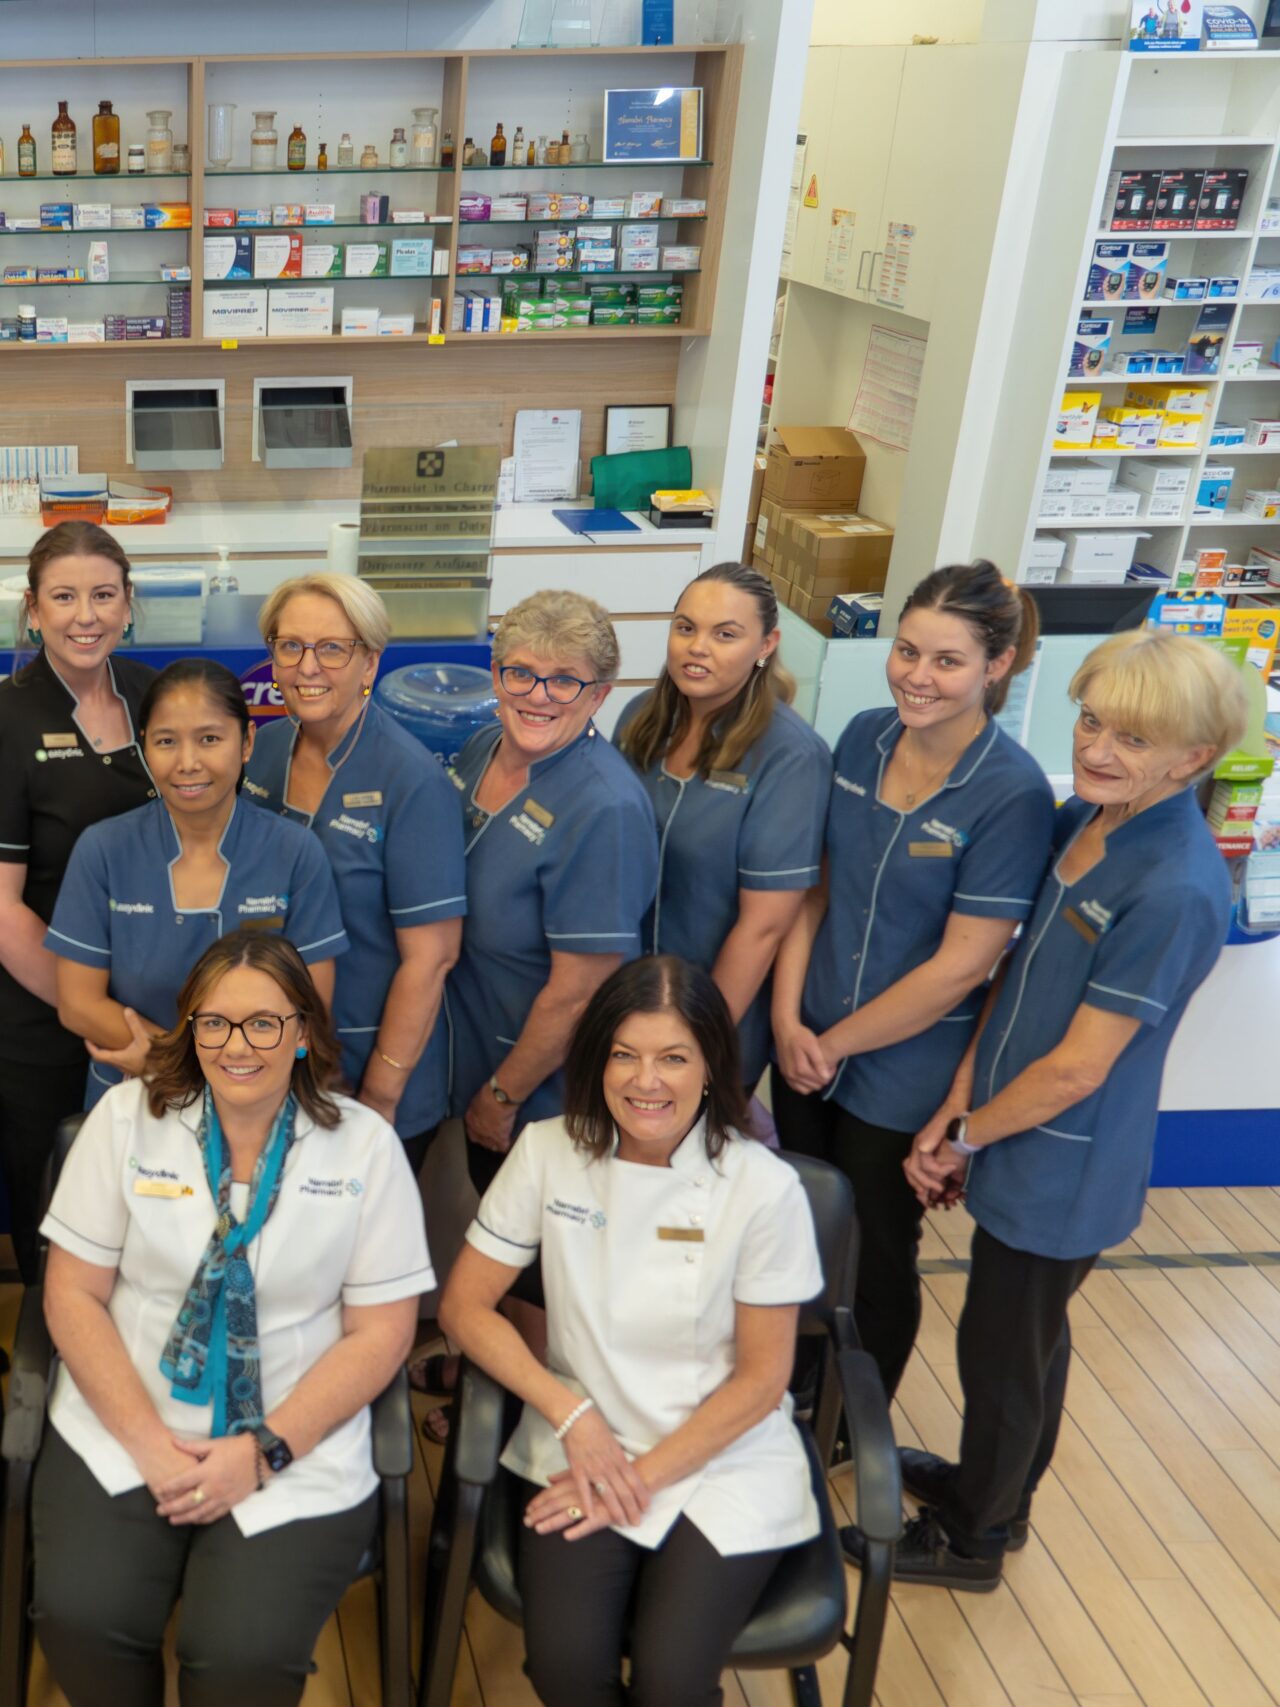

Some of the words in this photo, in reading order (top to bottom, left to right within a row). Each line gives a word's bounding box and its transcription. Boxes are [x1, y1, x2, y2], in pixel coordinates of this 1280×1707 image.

[363, 482, 427, 494] Pharmacist
[434, 483, 446, 493] in
[545, 1204, 587, 1225] Pharmacy
[553, 1199, 590, 1215] Narrabri
